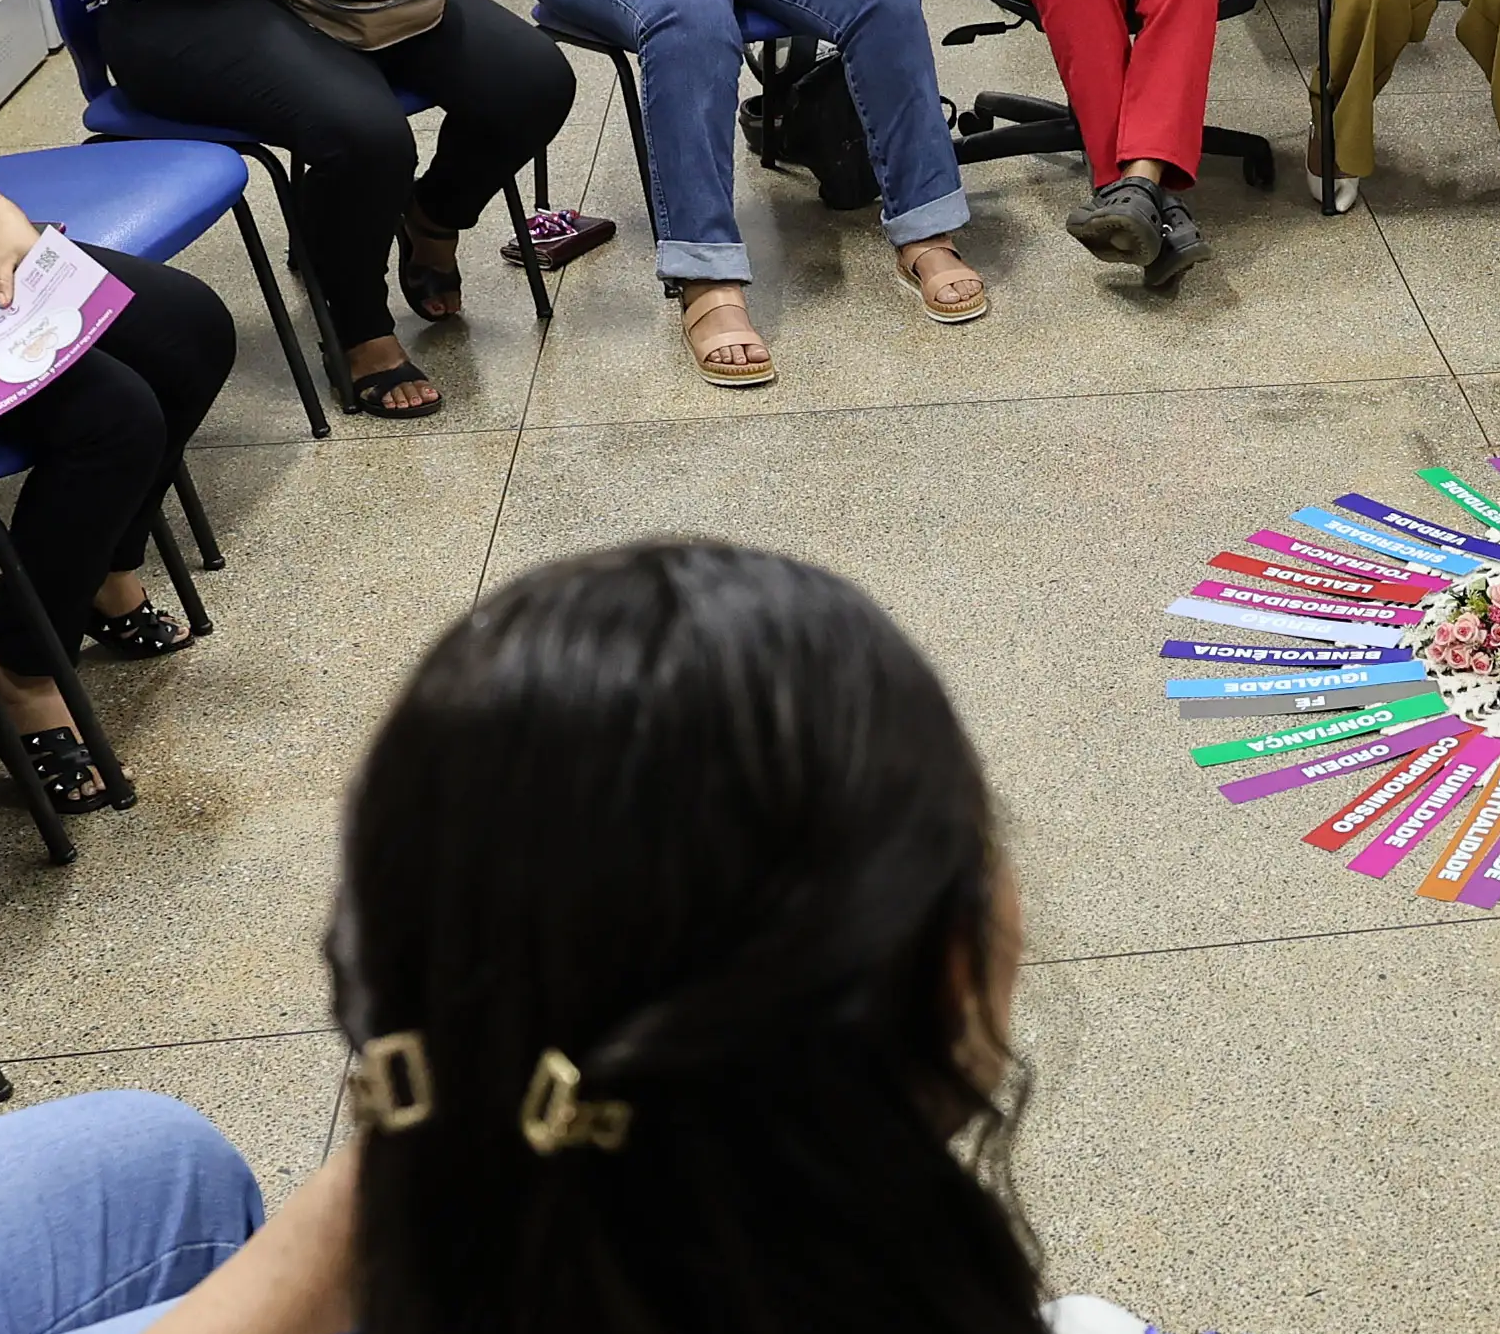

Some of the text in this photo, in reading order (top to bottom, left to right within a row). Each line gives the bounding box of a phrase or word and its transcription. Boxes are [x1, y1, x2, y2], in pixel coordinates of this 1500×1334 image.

[1325, 520, 1448, 564] SINCERIDADE
[1383, 513, 1464, 546] VERDADE
[1289, 542, 1412, 580] TOLERÂNCIA
[1262, 567, 1374, 593] LEALDADE
[1220, 587, 1396, 620] GENEROSIDADE
[1192, 645, 1382, 663] BENEVOLÊNCIA
[1224, 671, 1368, 693] IGUALDADE
[1295, 696, 1326, 710] FÉ
[1246, 709, 1394, 753] CONFIANÇA
[1301, 744, 1390, 779] ORDEM
[1332, 736, 1460, 833] COMPROMISSO
[1384, 764, 1477, 849] HUMILDADE
